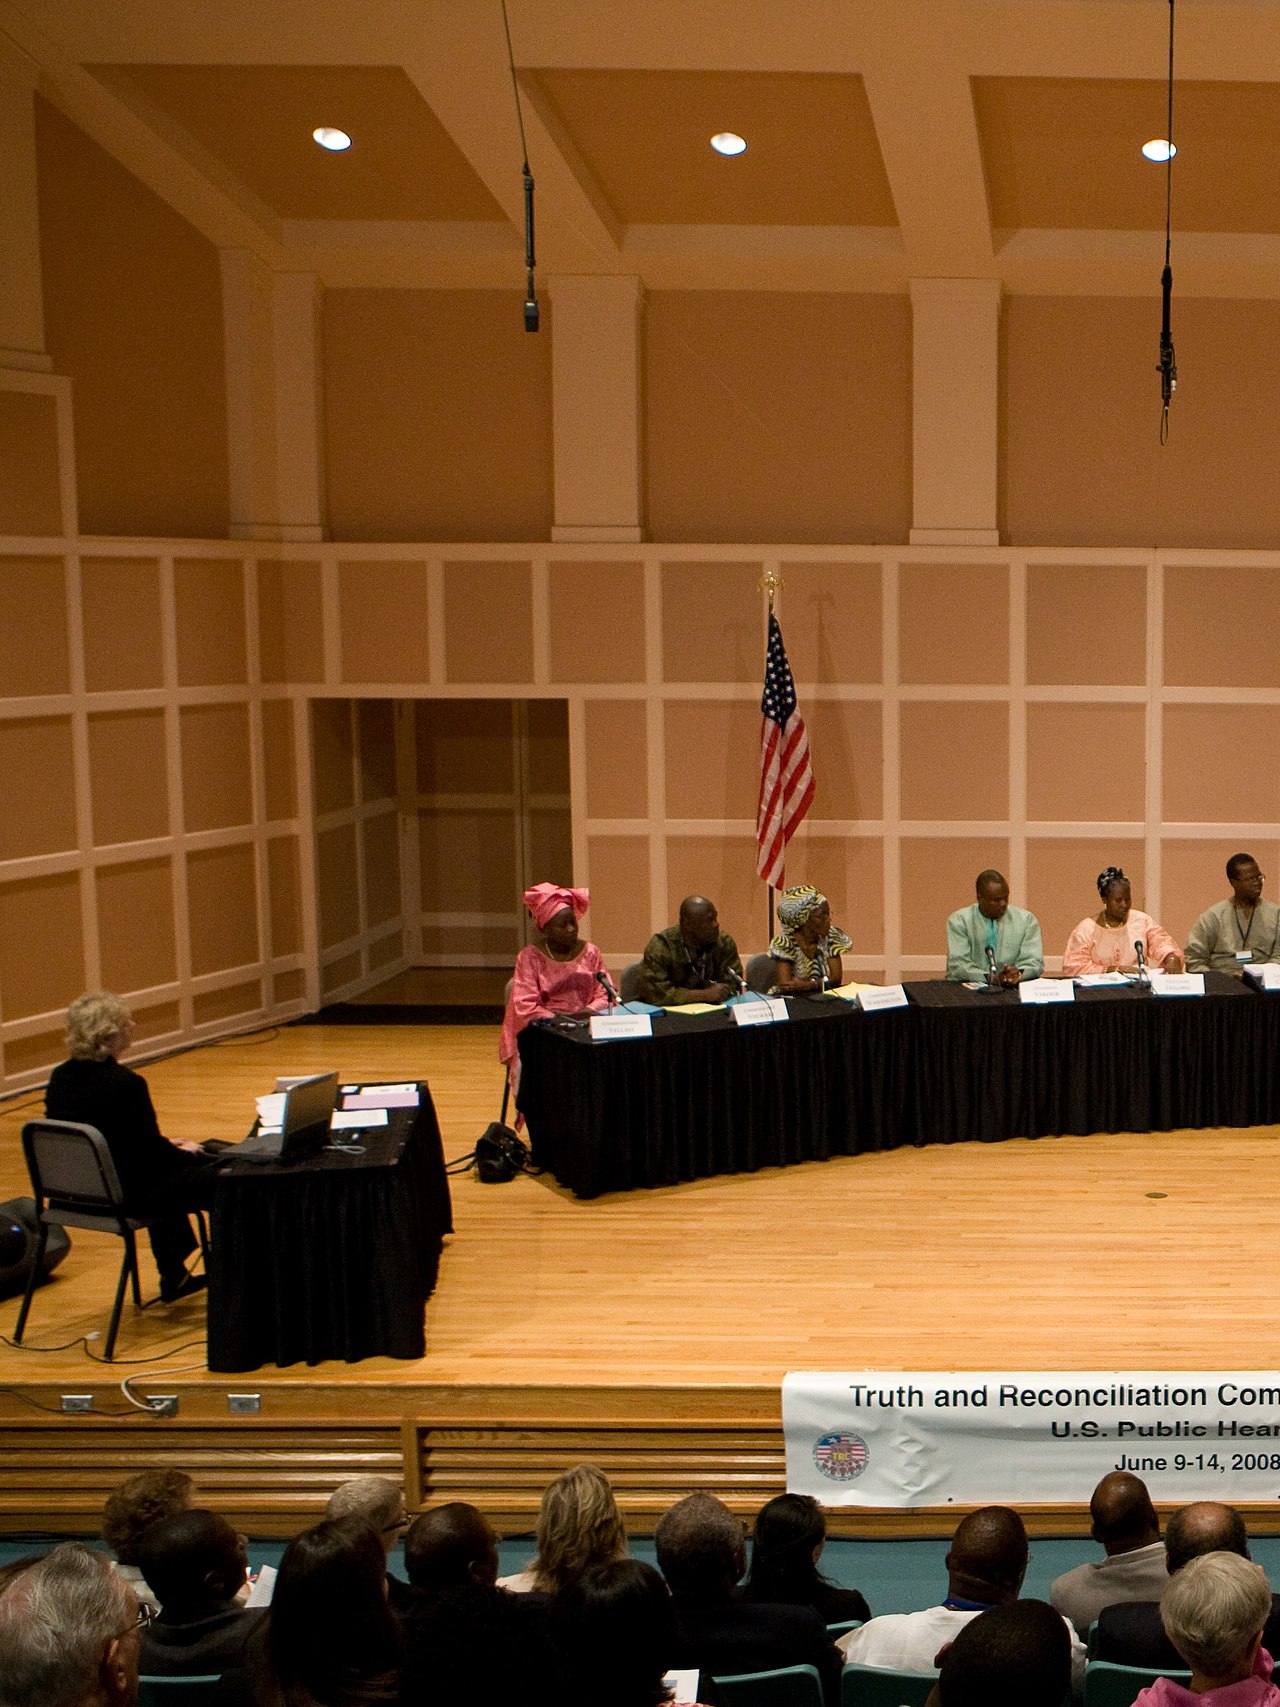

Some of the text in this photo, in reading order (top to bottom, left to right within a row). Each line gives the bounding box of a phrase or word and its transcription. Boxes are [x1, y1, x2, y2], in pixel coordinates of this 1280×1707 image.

[849, 1385, 923, 1407] Truth
[934, 1385, 987, 1407] and
[999, 1384, 1206, 1408] Reconciliation
[1051, 1421, 1107, 1438] U.S.
[1117, 1420, 1207, 1438] Public
[1114, 1454, 1167, 1471] June
[1174, 1454, 1225, 1474] 9-14,
